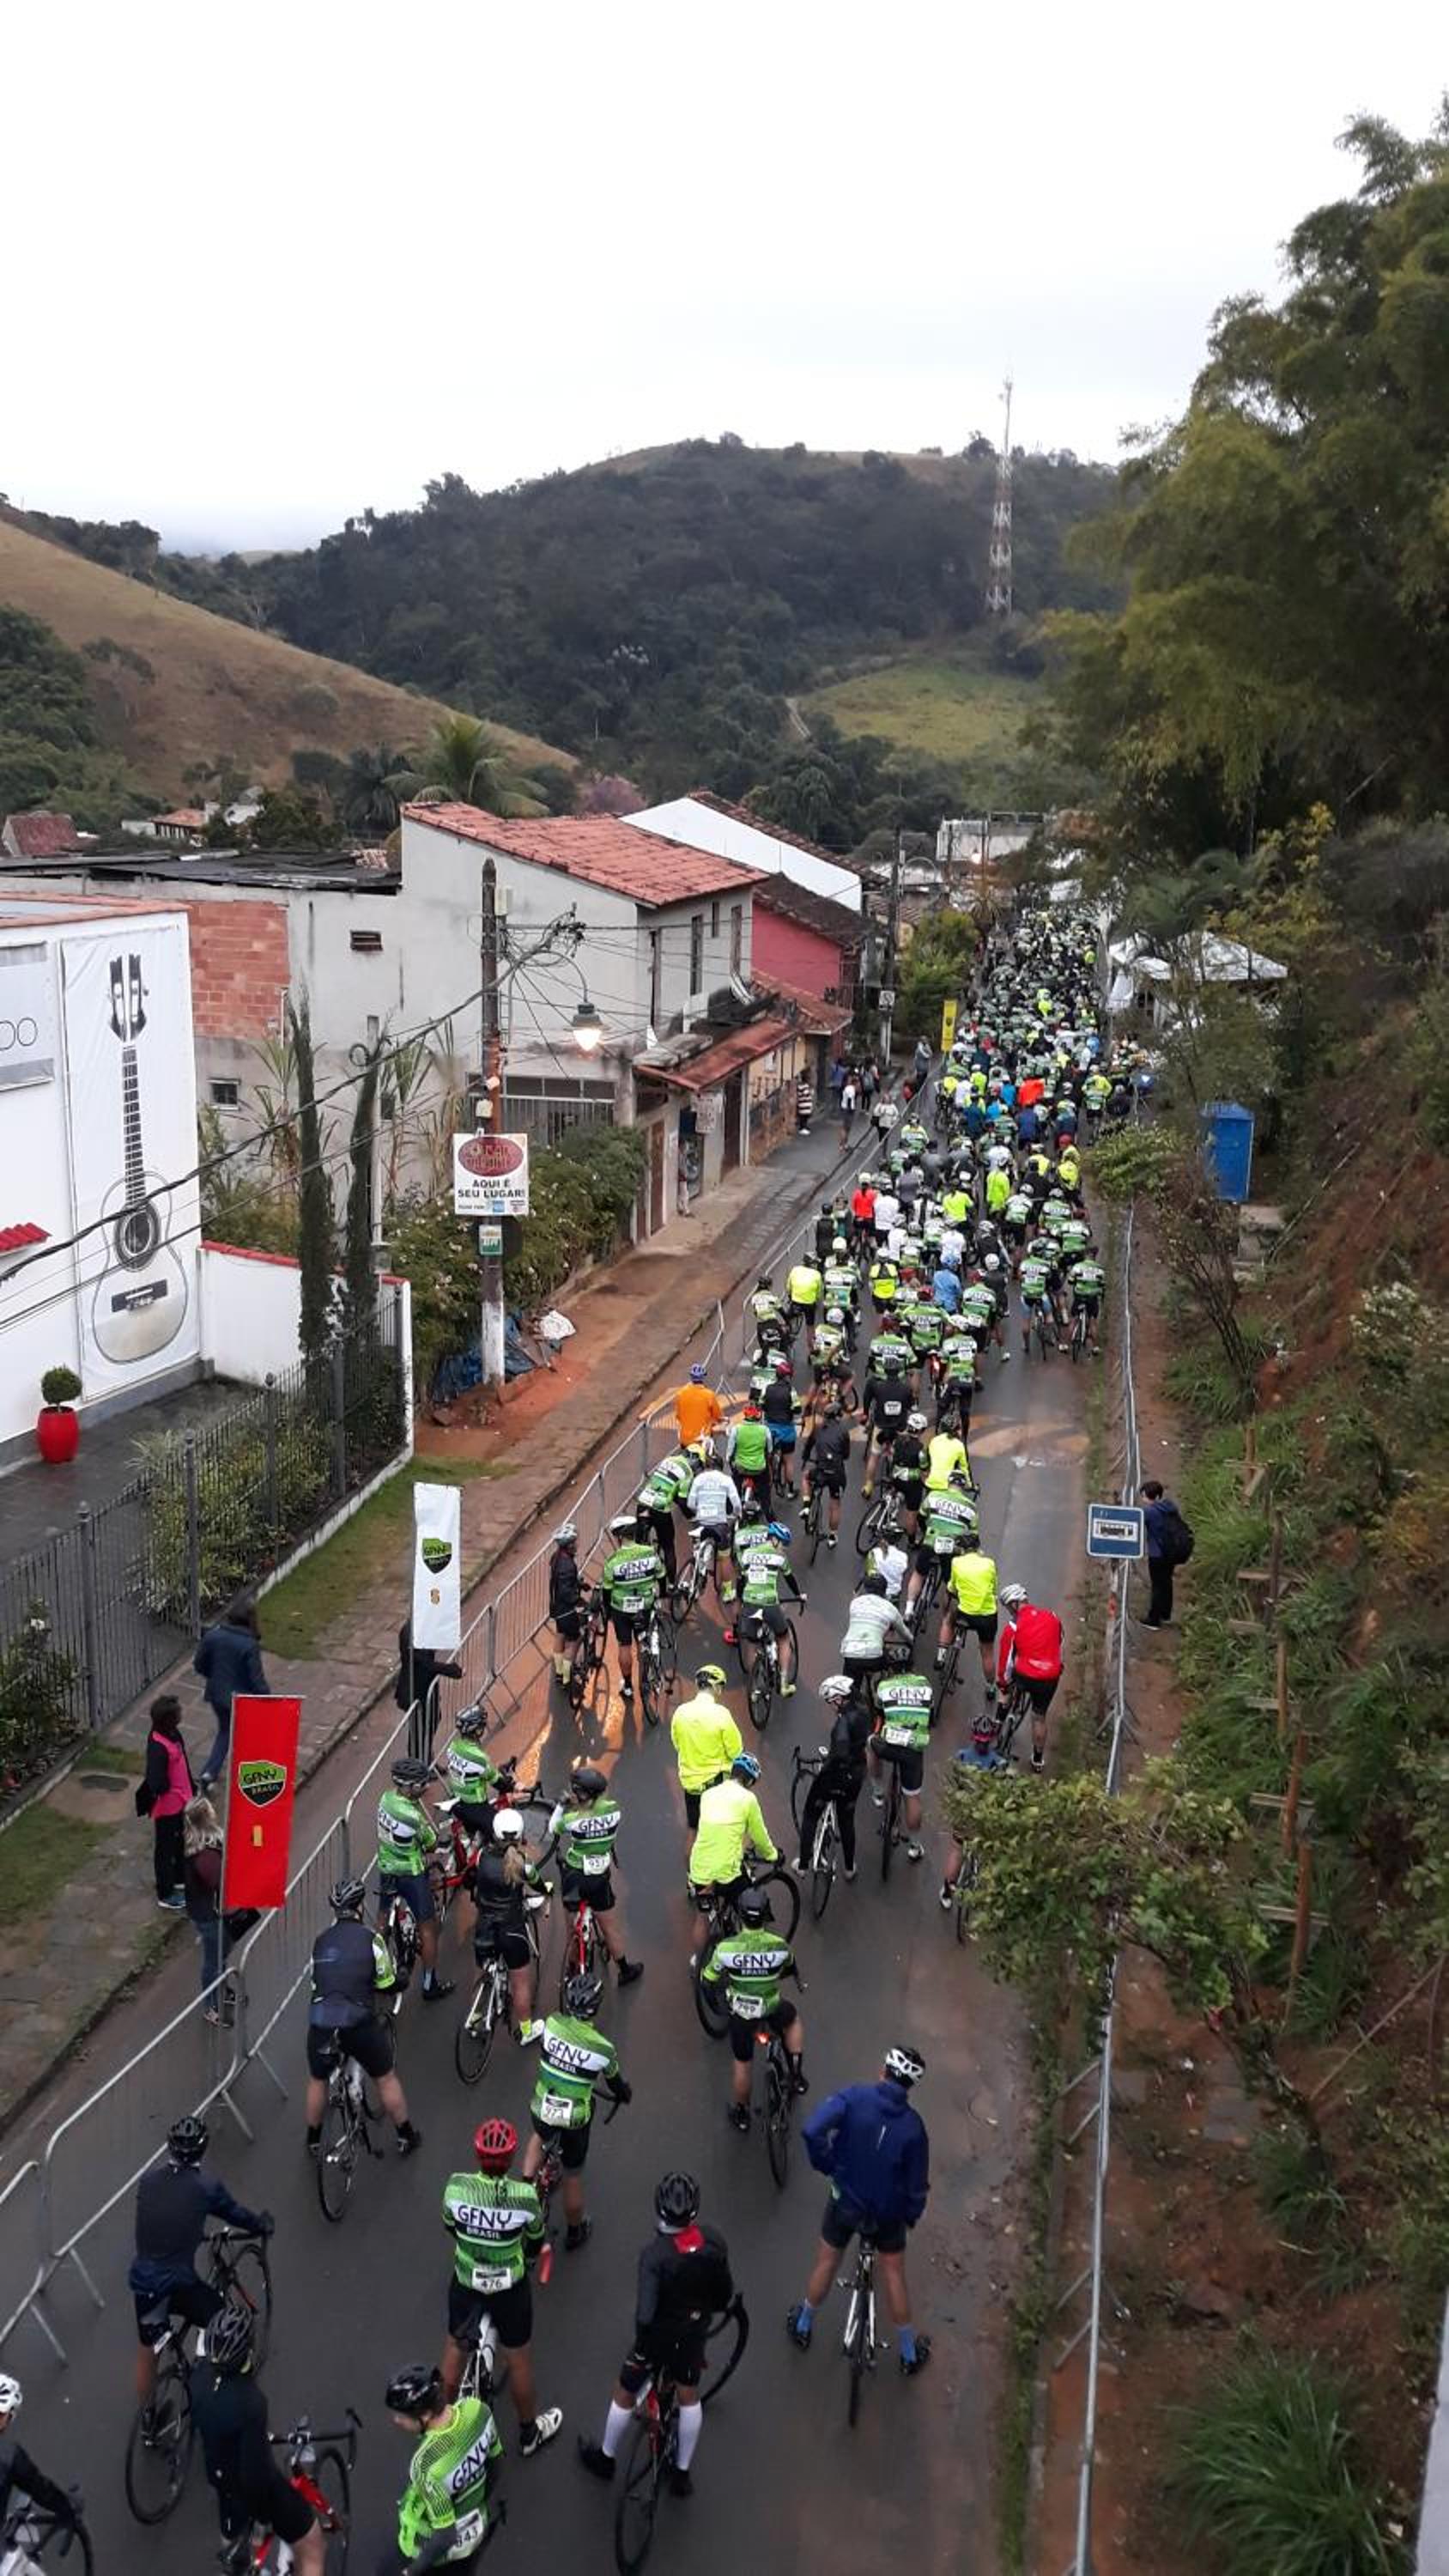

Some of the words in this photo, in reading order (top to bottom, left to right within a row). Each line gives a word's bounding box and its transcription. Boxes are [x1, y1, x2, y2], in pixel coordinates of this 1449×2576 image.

[472, 1179, 500, 1188] AQUI
[458, 1189, 480, 1198] SEU
[483, 1189, 525, 1199] LUGAR!
[243, 1769, 277, 1785] GFNY
[732, 1953, 777, 1969] GFNY
[548, 2037, 592, 2067] GFNY
[458, 2203, 512, 2230] GFNY
[466, 2225, 500, 2240] BRASIL
[480, 2279, 503, 2289] 476
